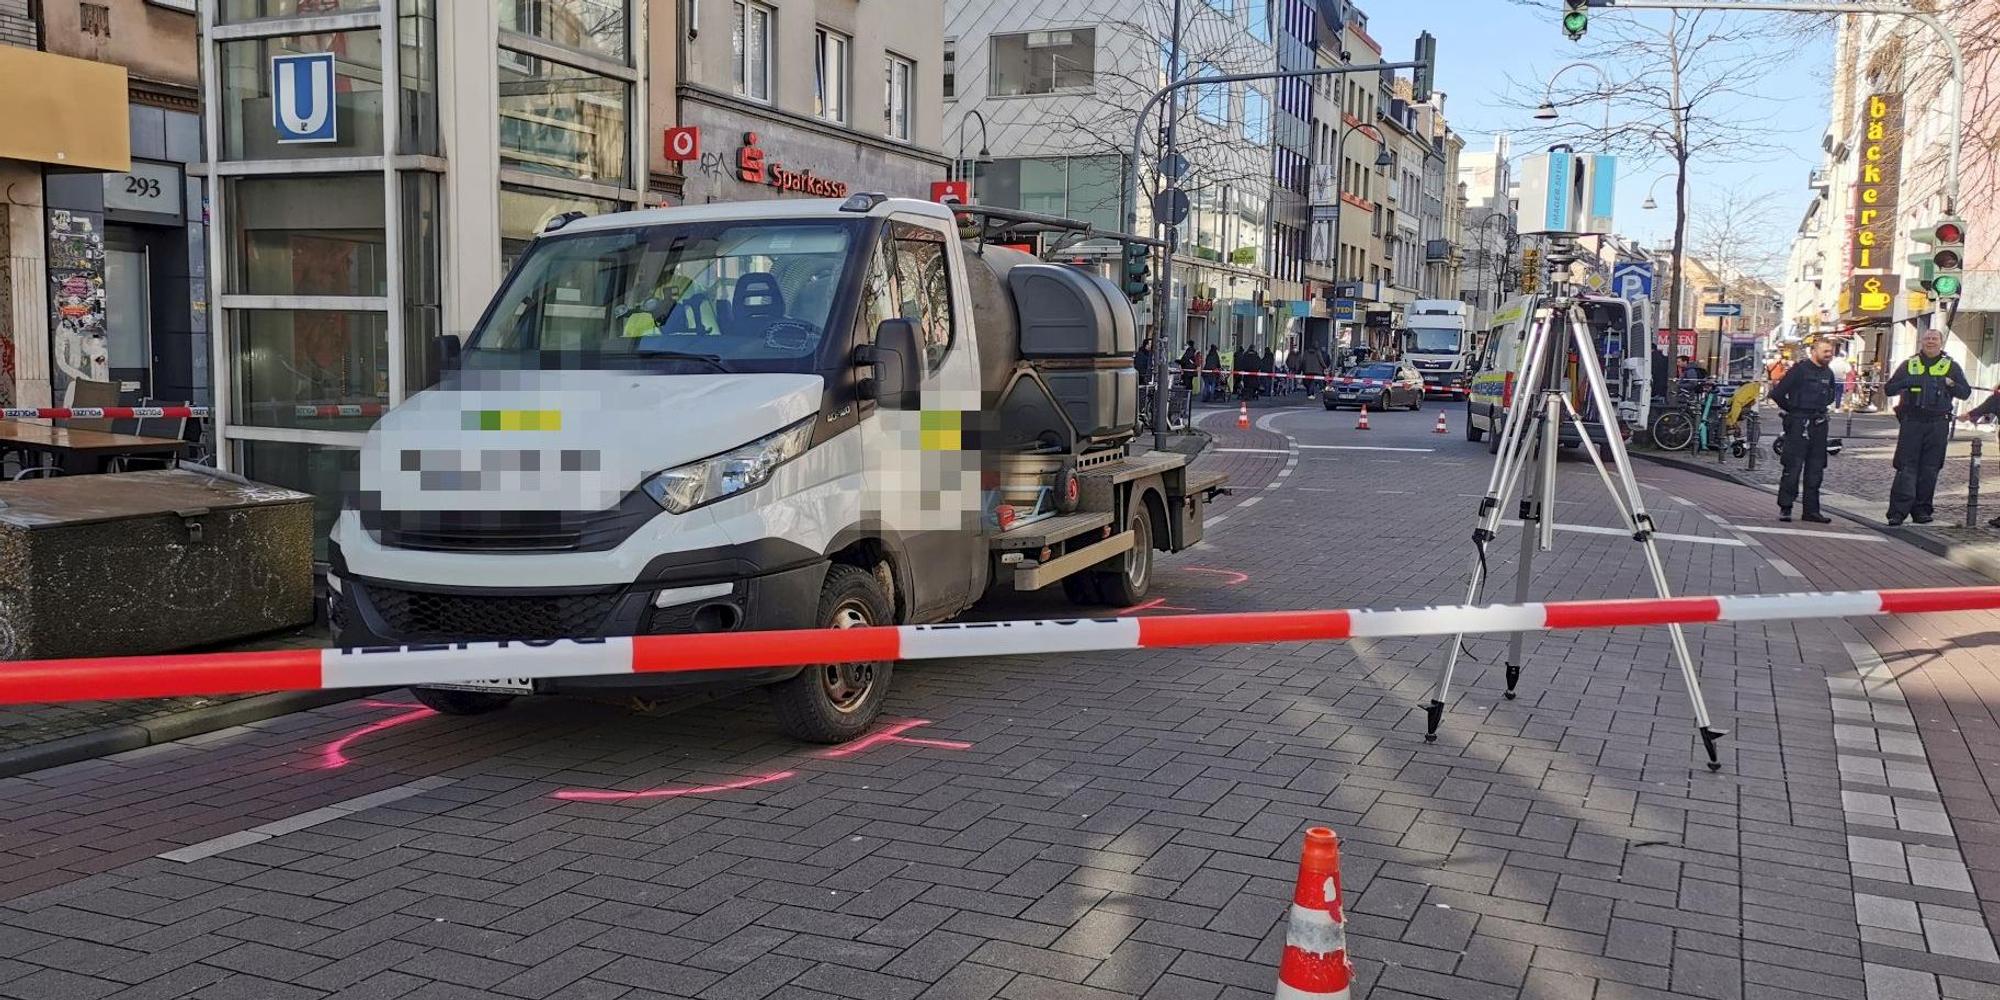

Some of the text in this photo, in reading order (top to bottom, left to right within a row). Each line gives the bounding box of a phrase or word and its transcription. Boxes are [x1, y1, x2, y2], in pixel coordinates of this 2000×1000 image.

[280, 62, 328, 134] U
[125, 176, 161, 198] 293
[769, 163, 848, 198] Sparkasse
[1859, 96, 1886, 267] bäckerei
[1621, 275, 1643, 300] P
